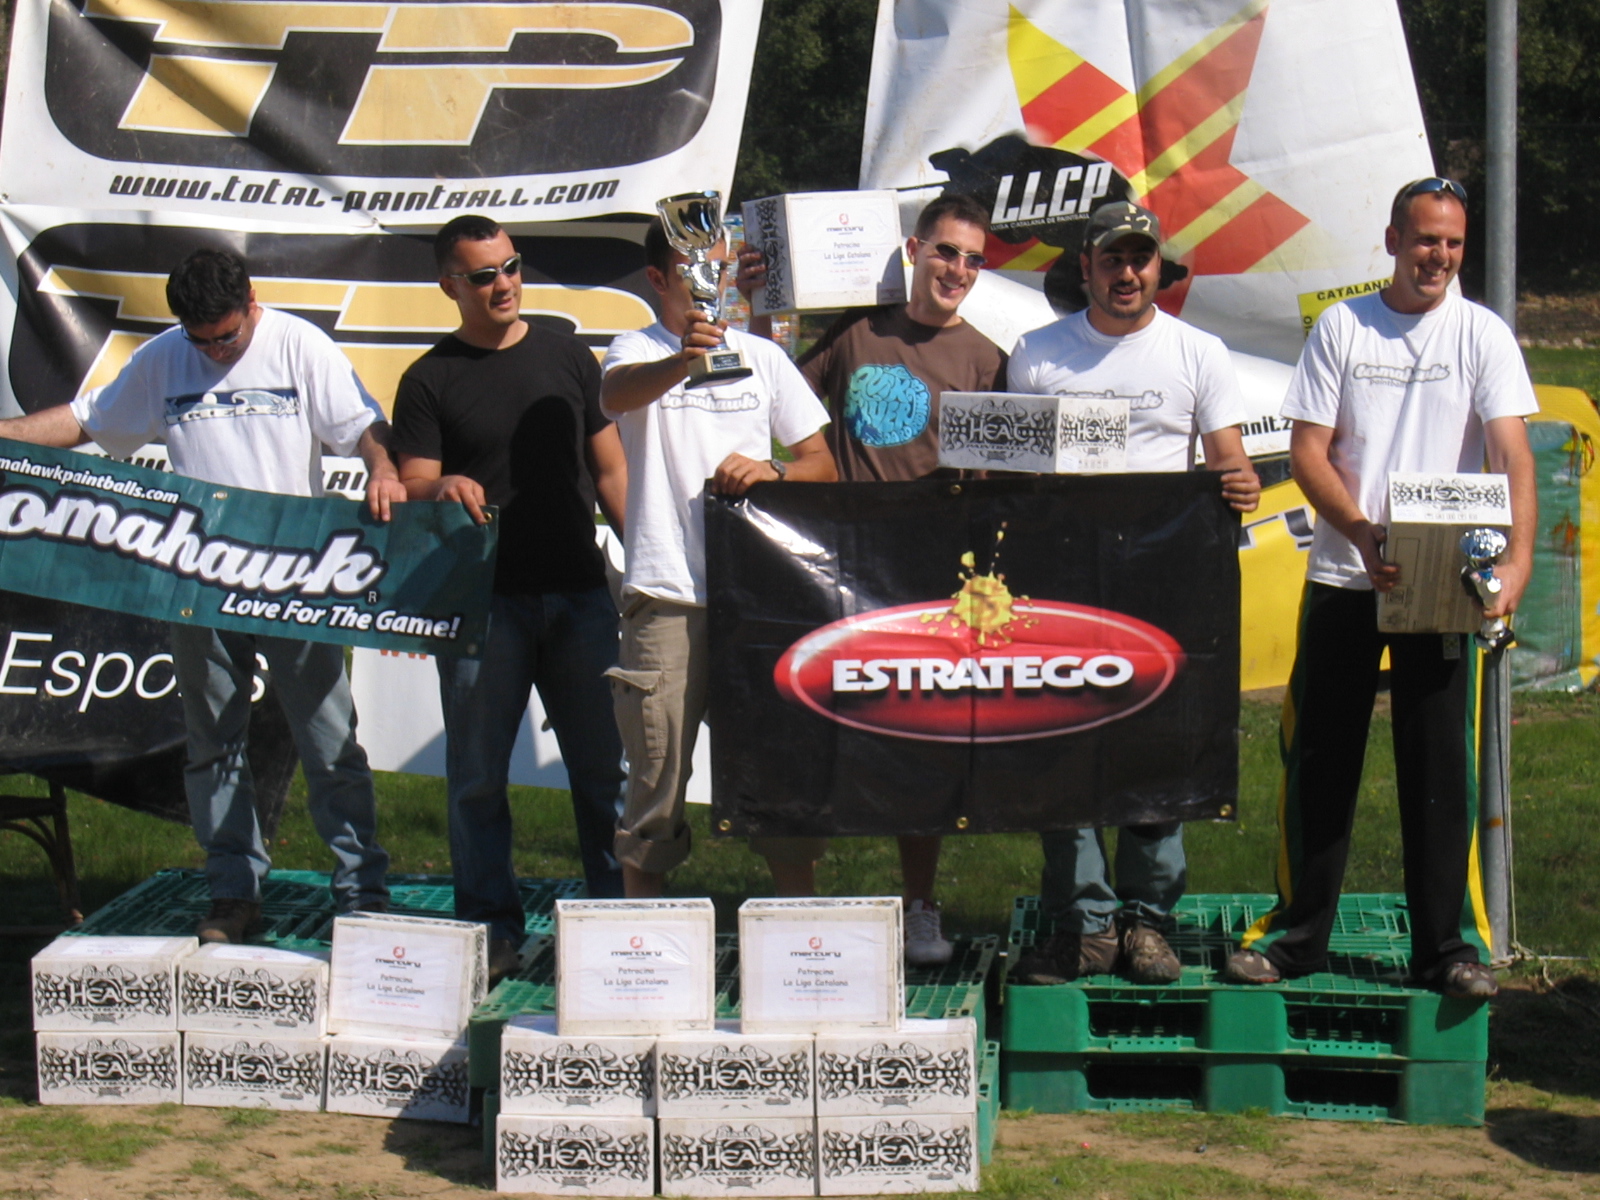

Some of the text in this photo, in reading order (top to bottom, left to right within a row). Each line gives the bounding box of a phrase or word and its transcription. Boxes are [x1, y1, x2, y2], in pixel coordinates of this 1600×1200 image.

[991, 162, 1112, 224] LLCP
[1317, 280, 1393, 301] CATALANA
[0, 457, 180, 505] mahawkpaintballs.com
[0, 491, 382, 594] omahawk
[221, 592, 461, 640] Love For The Game!
[832, 655, 1134, 693] ESTRATEGO
